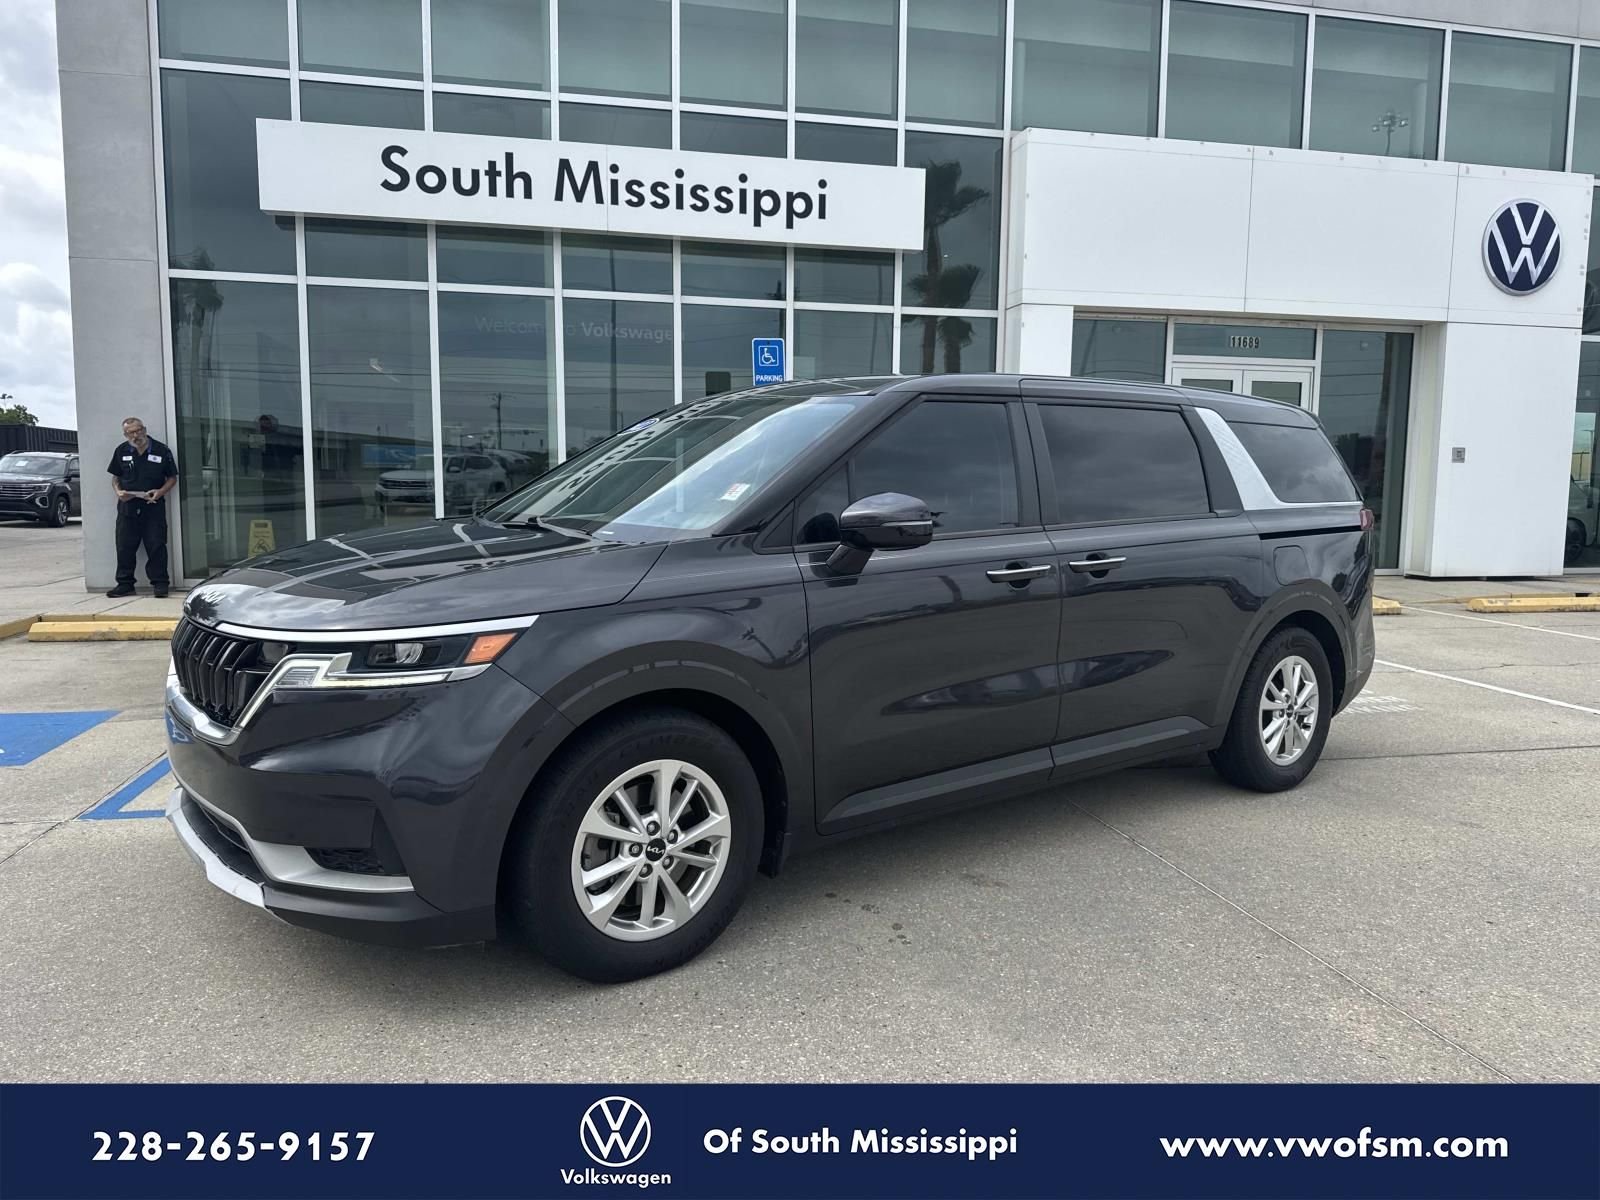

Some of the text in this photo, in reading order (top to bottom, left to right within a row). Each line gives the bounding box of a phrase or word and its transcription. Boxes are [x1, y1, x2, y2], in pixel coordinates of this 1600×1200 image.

[381, 145, 828, 230] South Mississippi
[474, 315, 551, 336] Welcom
[582, 321, 685, 344] Volkswage
[1231, 336, 1260, 349] 11689
[755, 374, 783, 382] PARKING
